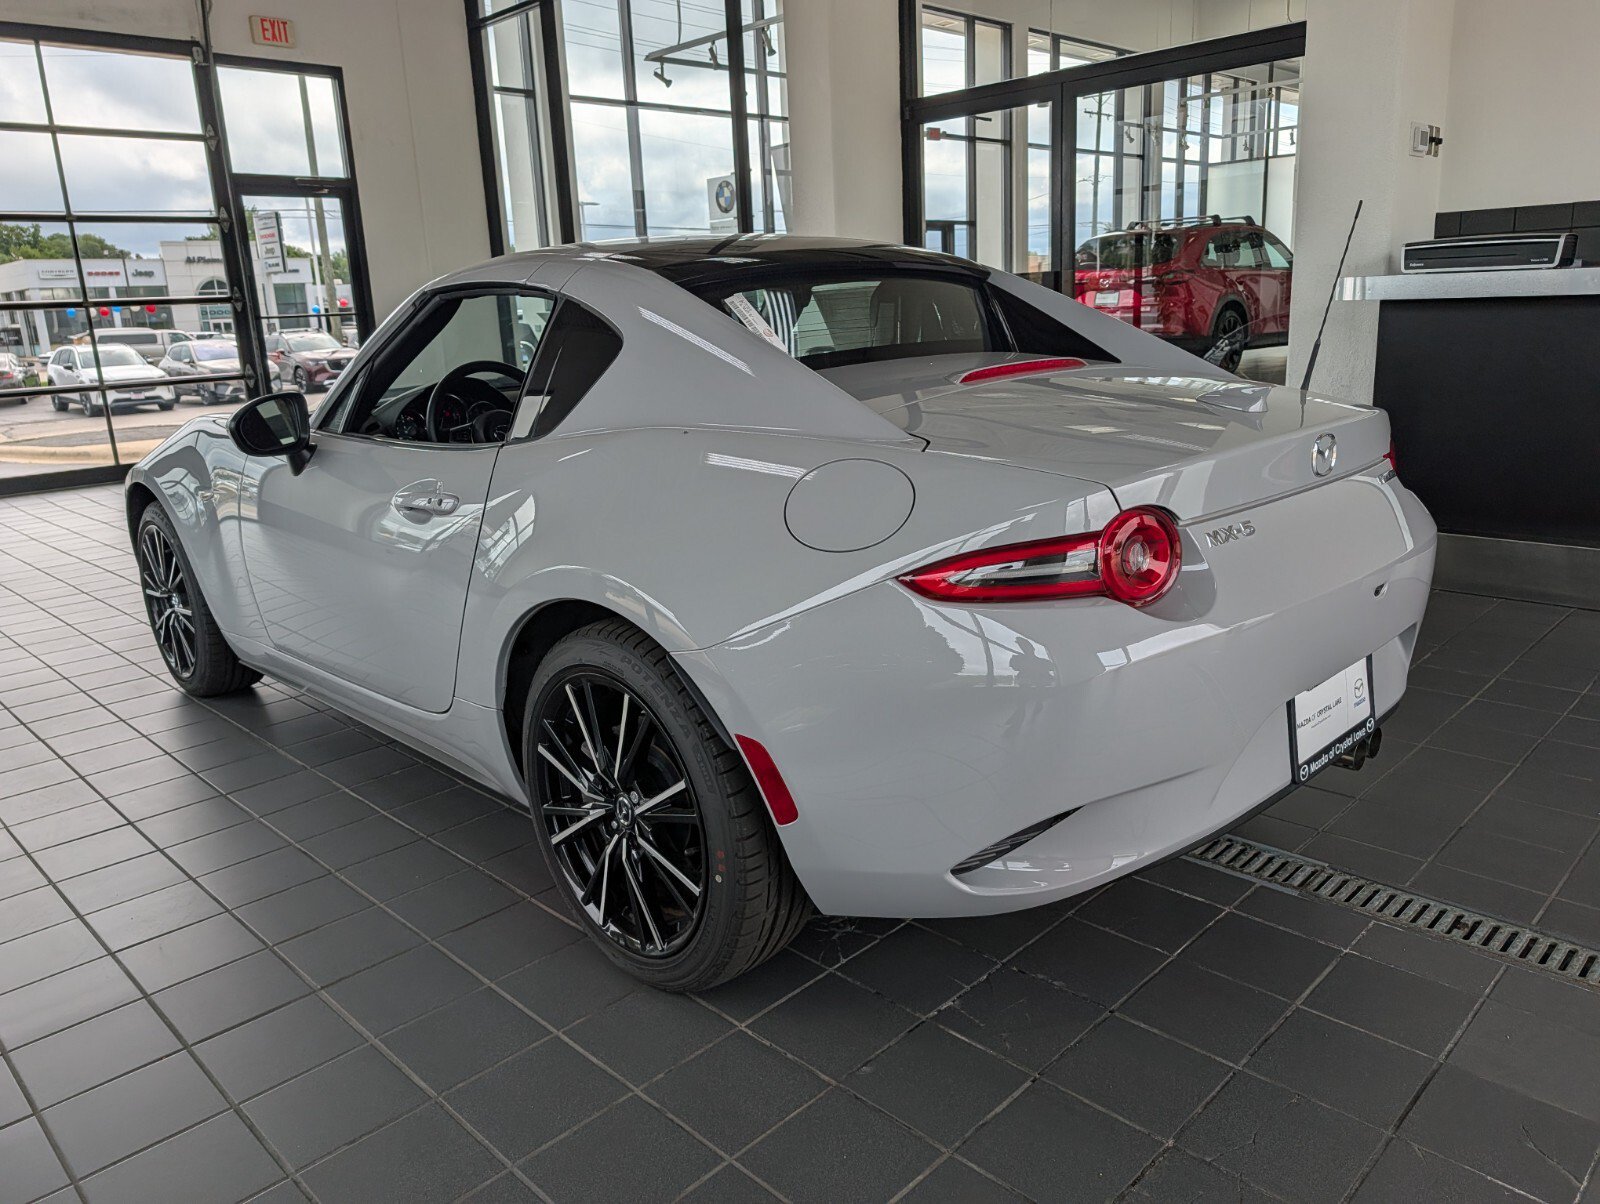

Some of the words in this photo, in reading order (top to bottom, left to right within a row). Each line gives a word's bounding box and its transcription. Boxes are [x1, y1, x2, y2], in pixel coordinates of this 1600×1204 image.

[260, 18, 289, 43] EXIT
[132, 269, 155, 278] Jeep
[1204, 519, 1256, 549] MX-5
[1296, 717, 1311, 729] MAZDA
[1317, 703, 1332, 718] CRYSTAL
[1332, 696, 1342, 708] LAKE
[1309, 753, 1329, 774] Mazda
[1328, 746, 1335, 760] of
[1335, 733, 1353, 754] Crystal
[1353, 727, 1366, 742] Lake
